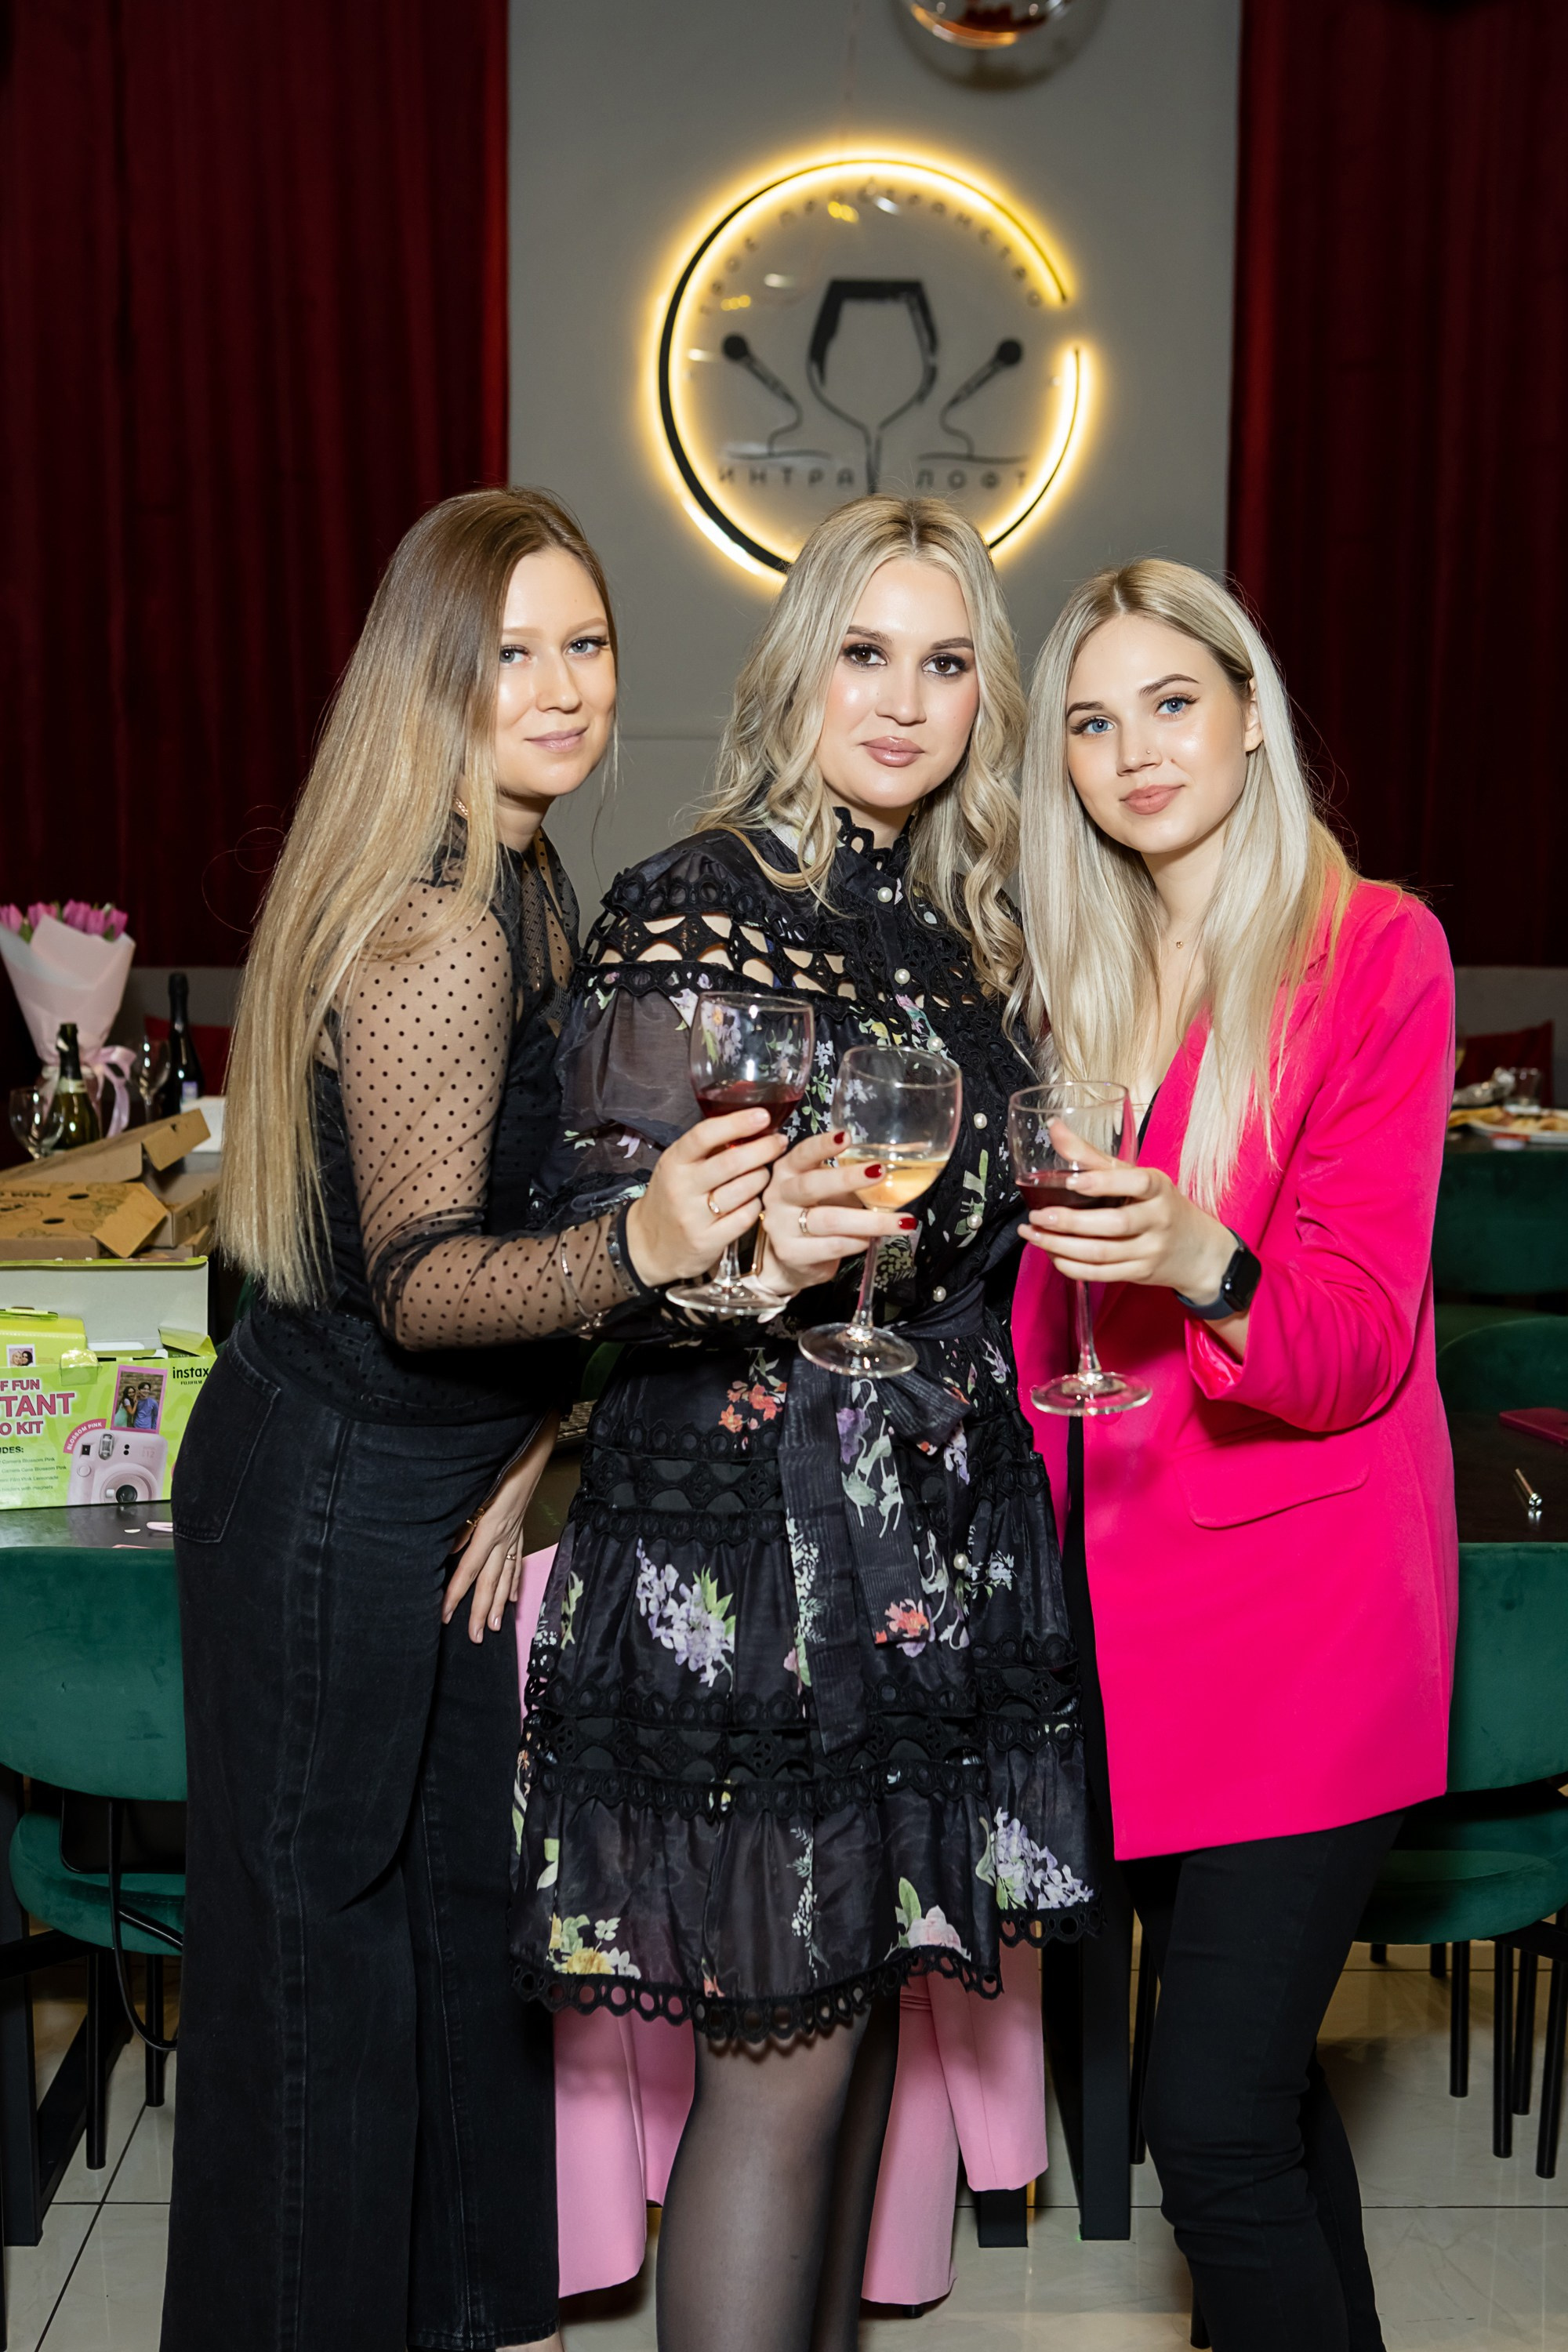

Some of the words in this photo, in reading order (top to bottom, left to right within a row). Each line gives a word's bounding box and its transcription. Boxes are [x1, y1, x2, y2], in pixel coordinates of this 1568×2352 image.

[718, 466, 855, 487] ИНТРА
[172, 1367, 209, 1379] instax
[0, 1381, 9, 1392] F
[12, 1379, 40, 1391] FUN
[16, 1421, 44, 1435] KIT
[67, 1425, 87, 1450] BLOSSOM
